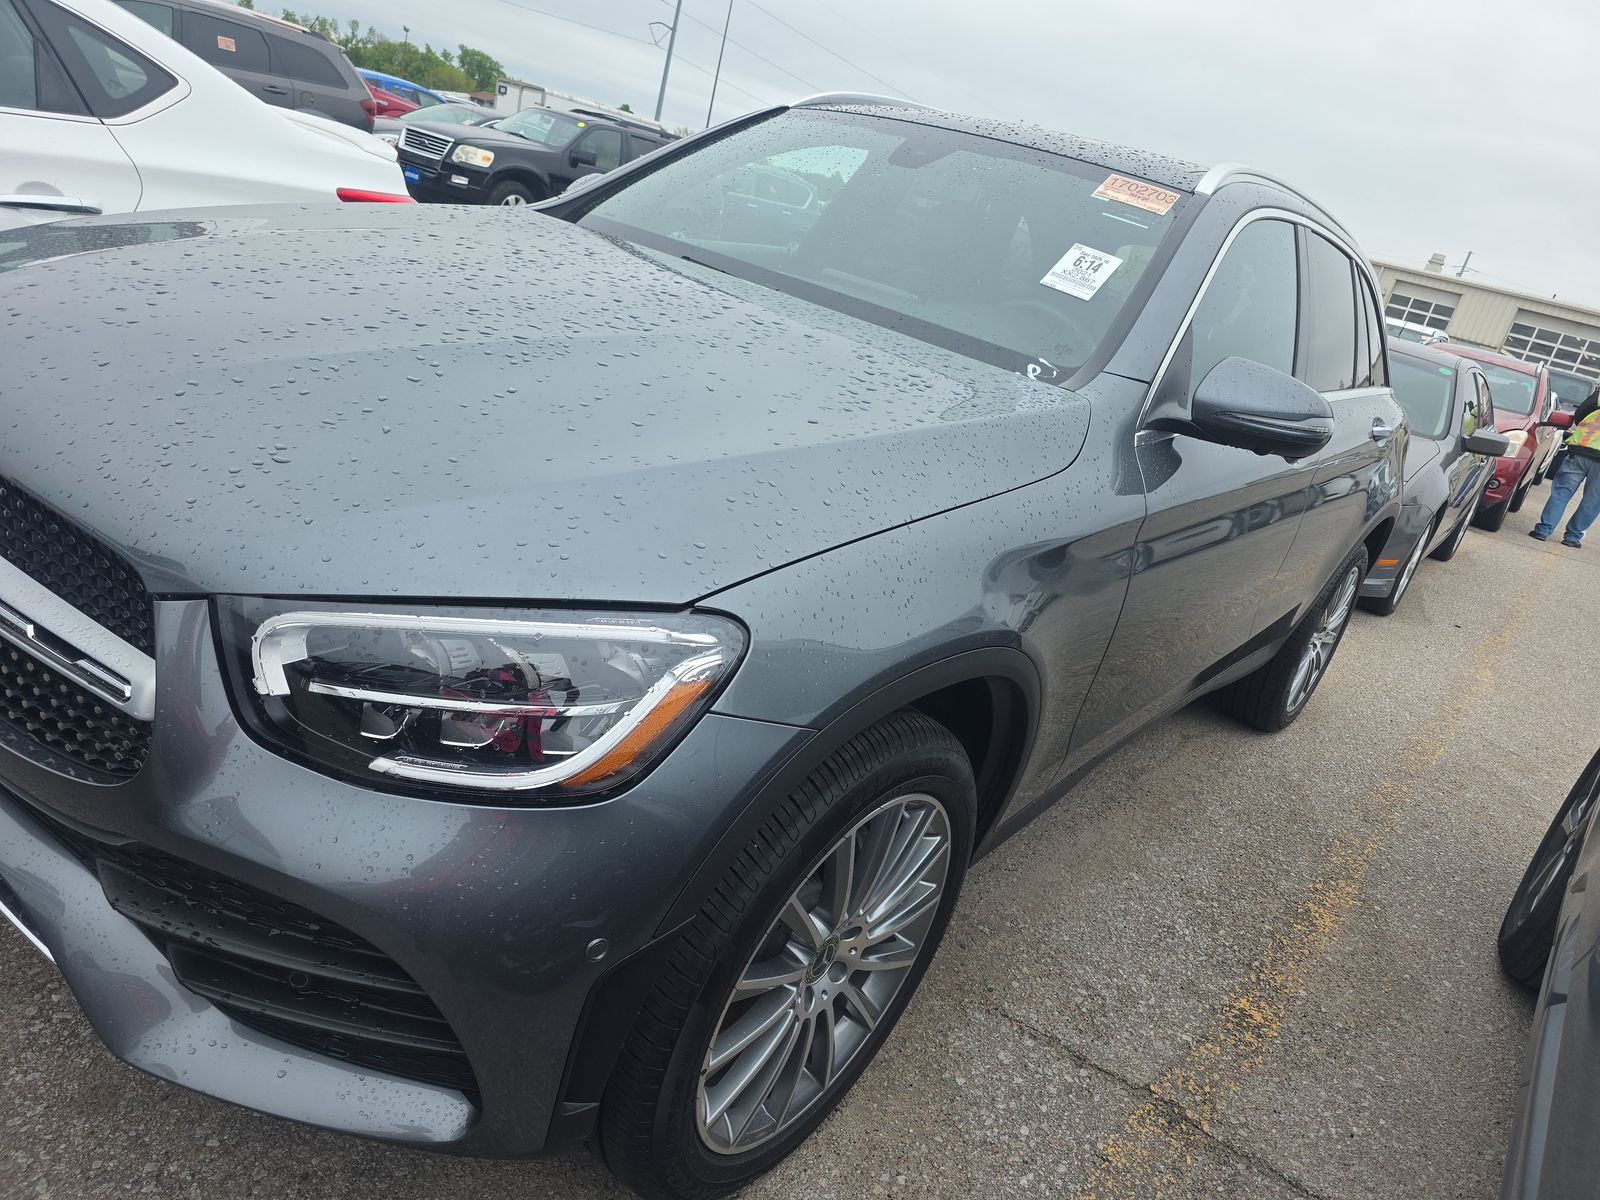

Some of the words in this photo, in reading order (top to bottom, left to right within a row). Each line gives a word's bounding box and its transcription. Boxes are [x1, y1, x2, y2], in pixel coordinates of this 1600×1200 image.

[1110, 177, 1177, 204] 1702703
[1071, 267, 1093, 277] 2021
[1073, 256, 1104, 273] 6:14
